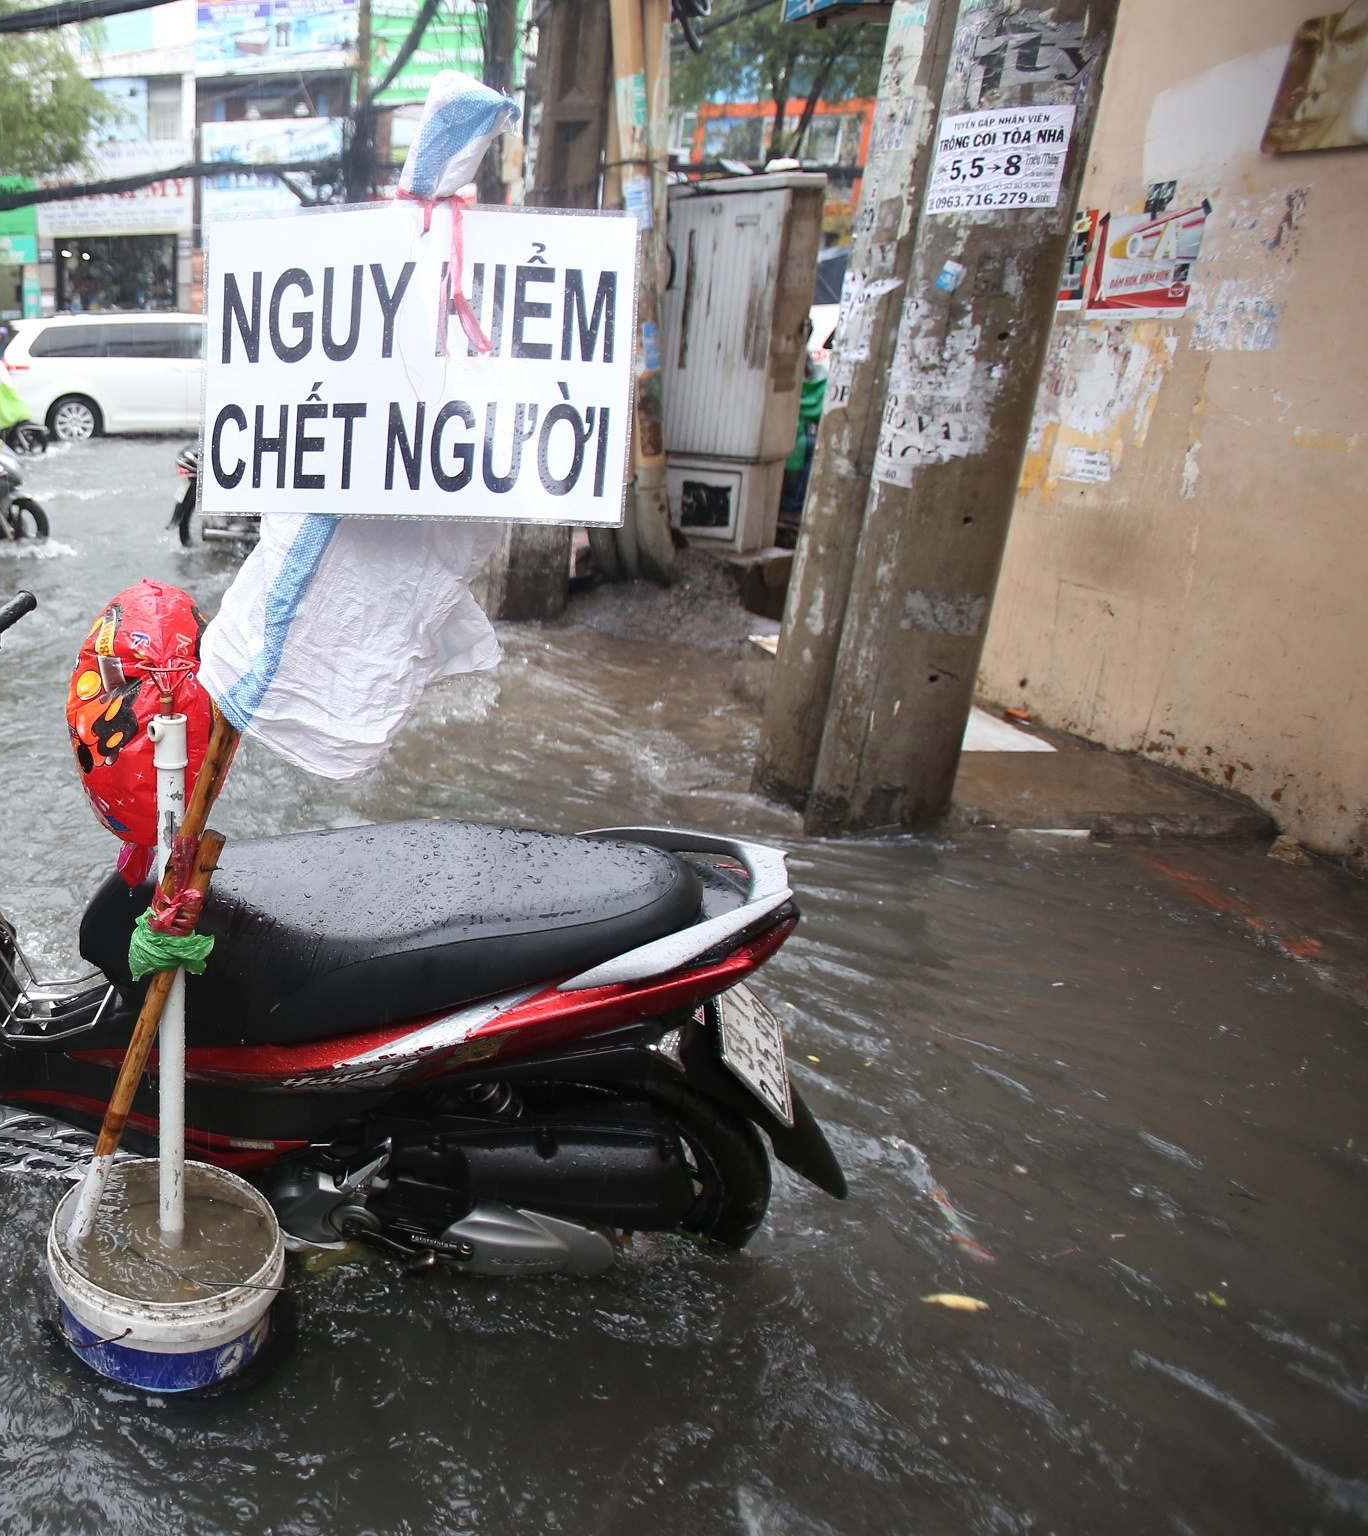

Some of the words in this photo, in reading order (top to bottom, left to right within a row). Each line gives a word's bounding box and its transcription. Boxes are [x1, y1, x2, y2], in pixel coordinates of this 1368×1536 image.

[998, 116, 1025, 125] NHÂN
[1028, 114, 1050, 123] VIÊN
[939, 134, 970, 152] TRÔNG
[973, 133, 996, 146] COI
[1037, 125, 1064, 143] NHÀ
[936, 191, 1028, 208] 0963.716.279
[221, 261, 417, 364] NGUY
[434, 242, 618, 364] HIỂM
[210, 381, 367, 490] CHẾT
[384, 381, 611, 497] NGƯỜI
